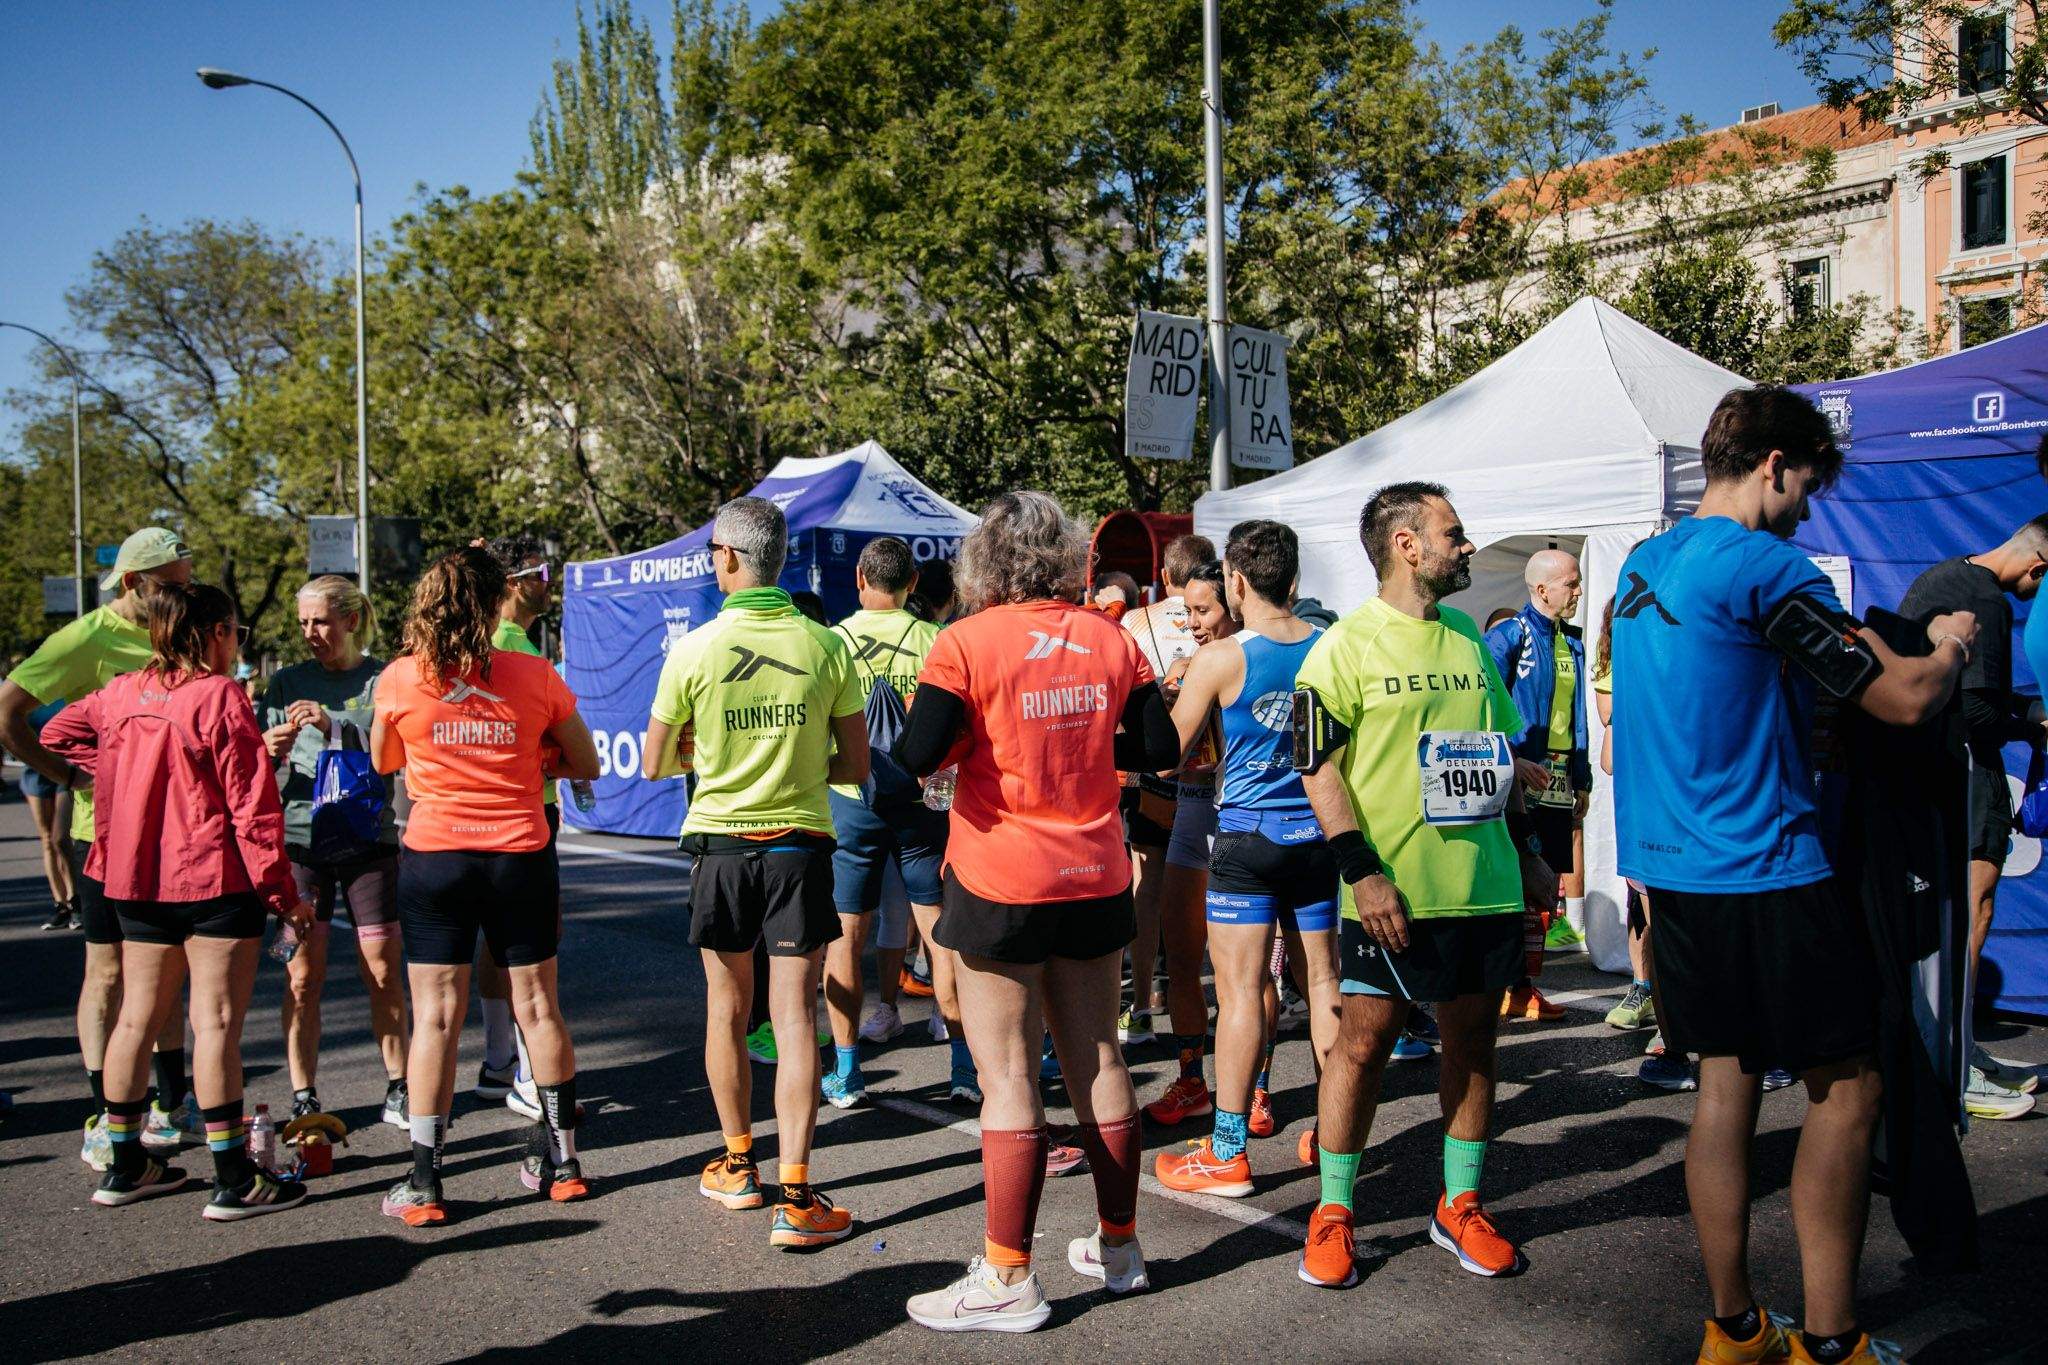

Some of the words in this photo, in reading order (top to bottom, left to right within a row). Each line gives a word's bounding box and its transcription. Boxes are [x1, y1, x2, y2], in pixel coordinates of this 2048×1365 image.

[1134, 321, 1200, 361] MAD
[1232, 337, 1276, 376] CUL
[1150, 361, 1196, 397] RID
[1237, 372, 1268, 409] TU
[1251, 411, 1288, 446] RA
[1141, 443, 1171, 454] MADRID
[1245, 453, 1271, 464] MADRID
[753, 694, 768, 702] CLUB
[1021, 683, 1108, 720] RUNNERS
[724, 703, 806, 732] RUNNERS
[1051, 720, 1083, 731] DECIMAS
[433, 721, 517, 744] RUNNERS
[592, 729, 648, 779] BO
[1450, 744, 1491, 752] BOMBEROS
[1446, 759, 1494, 767] DECIMAS
[1180, 786, 1211, 799] NIKE
[1440, 768, 1497, 797] 1940
